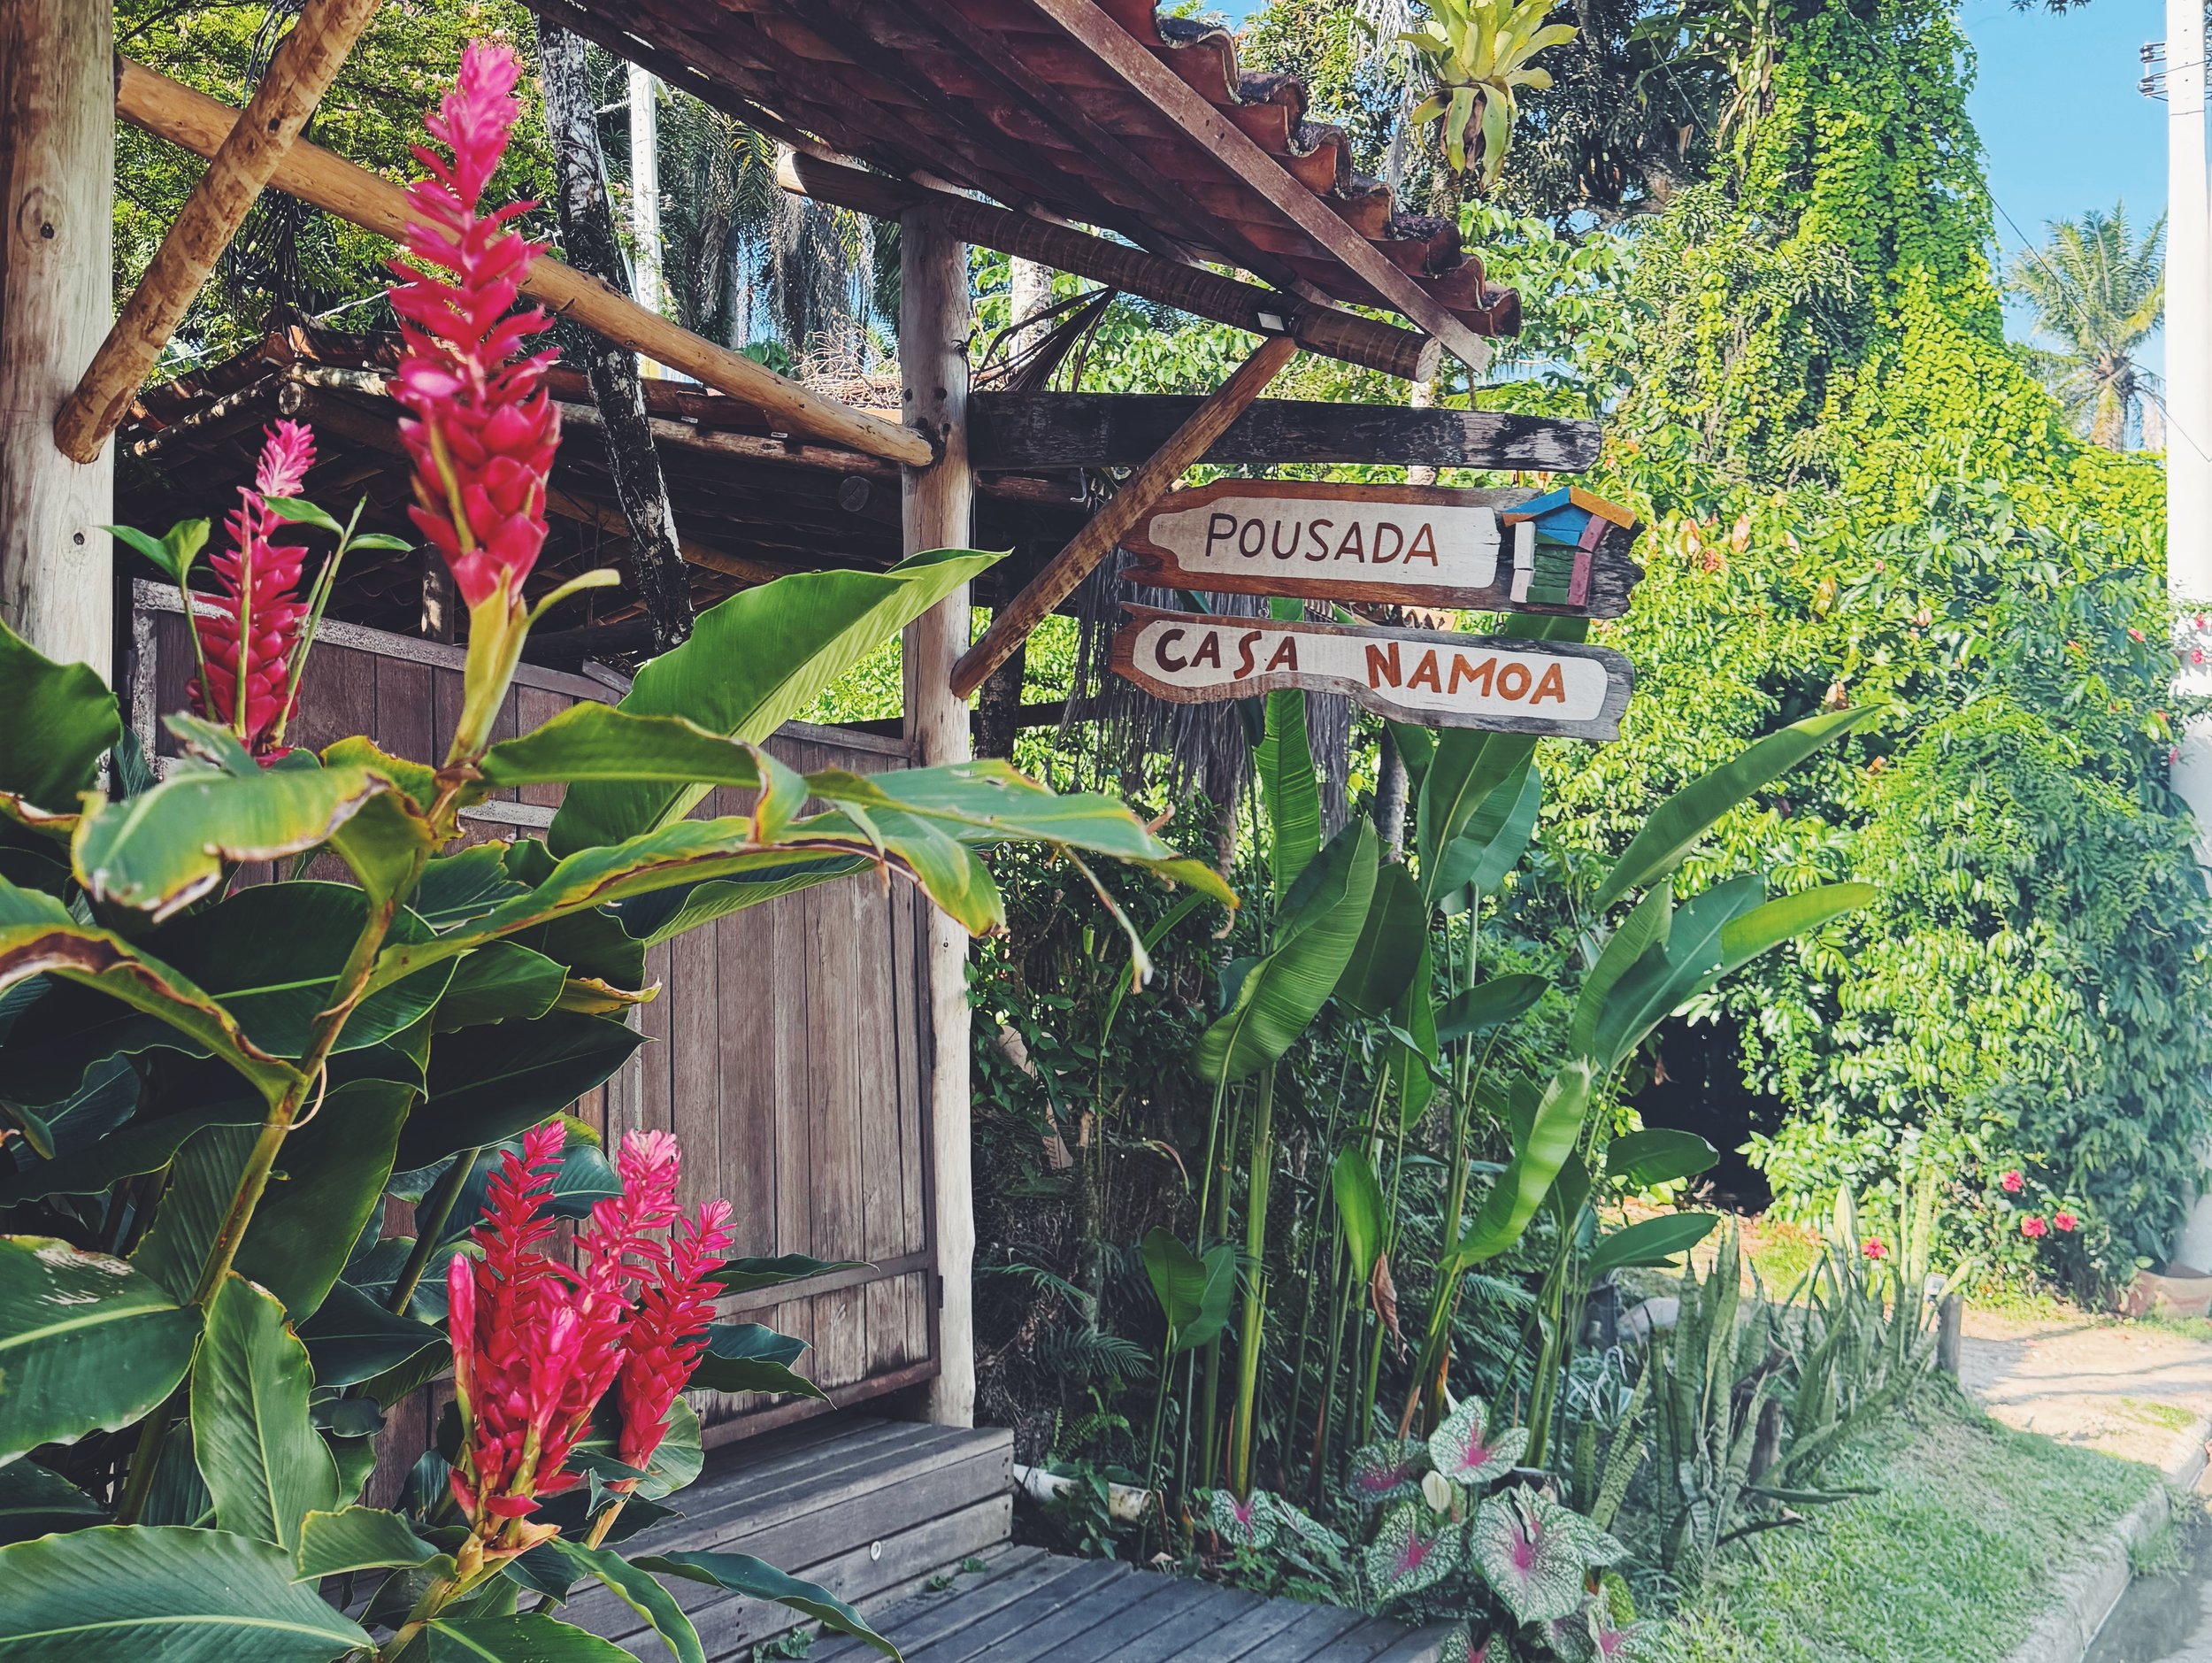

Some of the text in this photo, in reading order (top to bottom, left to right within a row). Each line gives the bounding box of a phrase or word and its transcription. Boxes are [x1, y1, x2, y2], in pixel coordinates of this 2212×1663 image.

[1205, 512, 1439, 566] POUSADA
[1155, 628, 1566, 704] CASA NAMOA
